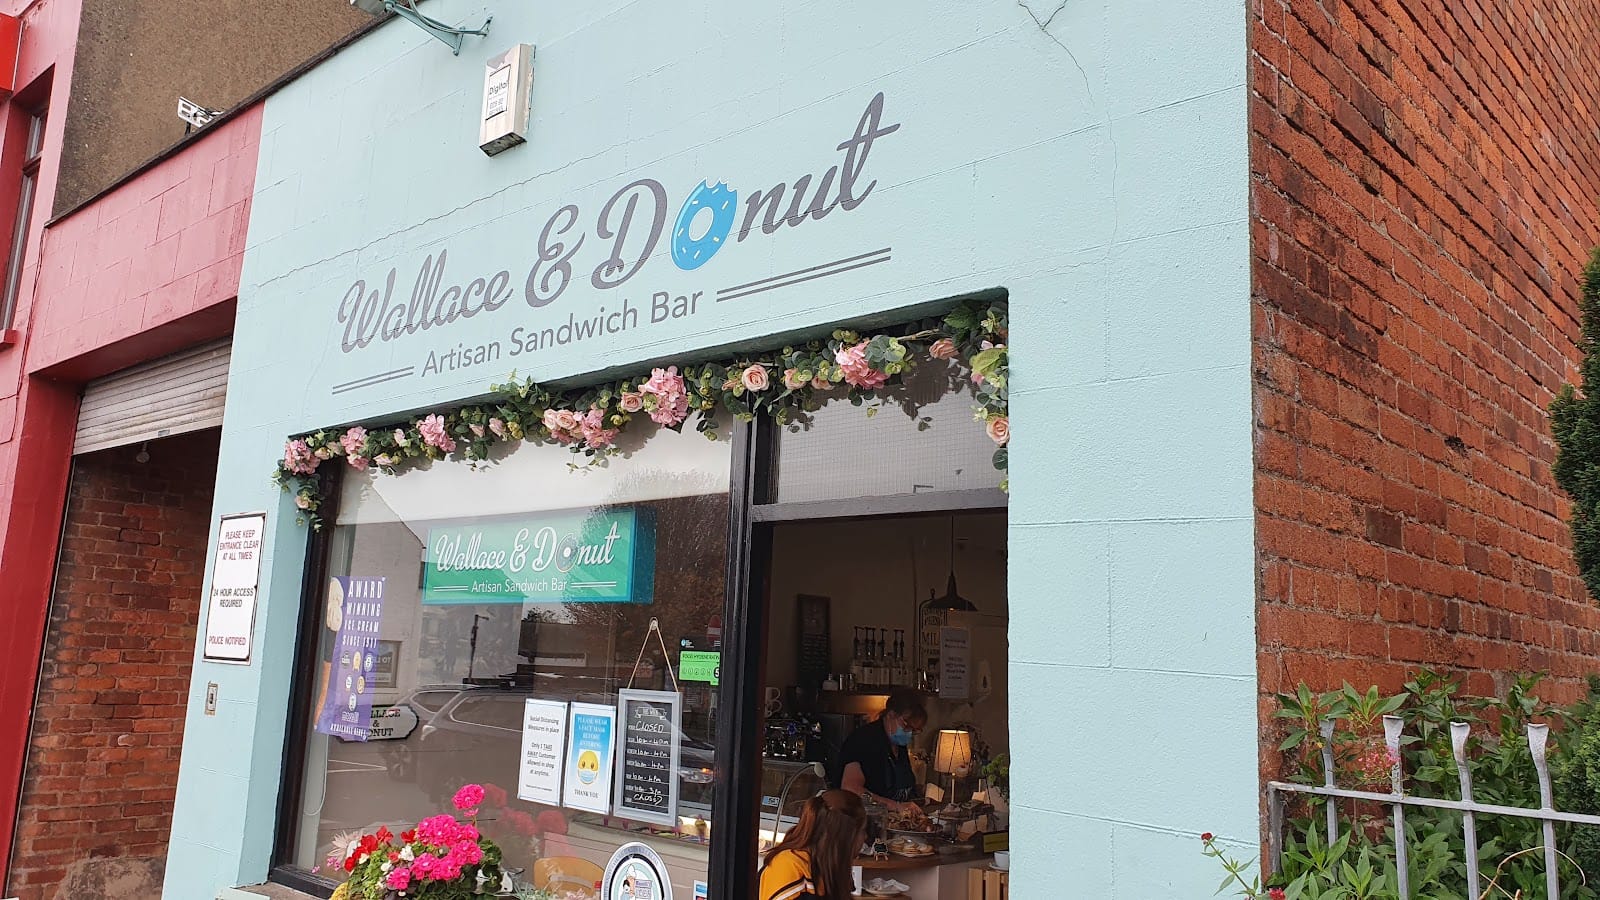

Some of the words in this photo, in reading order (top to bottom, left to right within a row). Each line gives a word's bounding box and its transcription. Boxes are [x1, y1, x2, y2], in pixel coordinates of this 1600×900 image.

[337, 248, 513, 354] Wallace
[525, 204, 585, 308] &
[420, 340, 500, 377] Artisan
[509, 301, 638, 357] Sandwich
[649, 287, 704, 322] Bar
[225, 530, 242, 539] PLEASE
[243, 529, 256, 538] KEEP
[219, 541, 242, 551] ENTRANCE
[243, 540, 260, 549] CLEAR
[436, 533, 506, 571] Wallace
[509, 527, 530, 572] &
[222, 552, 228, 560] AT
[228, 552, 236, 560] ALL
[238, 551, 253, 560] TIMES
[347, 580, 383, 599] AWARD
[471, 579, 502, 593] Artisan
[505, 577, 548, 593] Sandwich
[551, 577, 567, 590] Bar
[213, 588, 219, 596] 24
[220, 588, 232, 597] HOUR
[233, 588, 254, 597] ACCESS
[219, 599, 243, 608] REQUIRED
[346, 602, 381, 617] WINNING
[344, 619, 355, 631] ICE
[357, 620, 379, 632] CREAM
[208, 635, 224, 645] POLICE
[225, 636, 247, 646] NOTIFIED
[342, 634, 361, 647] SINCE
[372, 719, 380, 728] &
[577, 716, 593, 724] PLEASE
[574, 789, 589, 797] THANK
